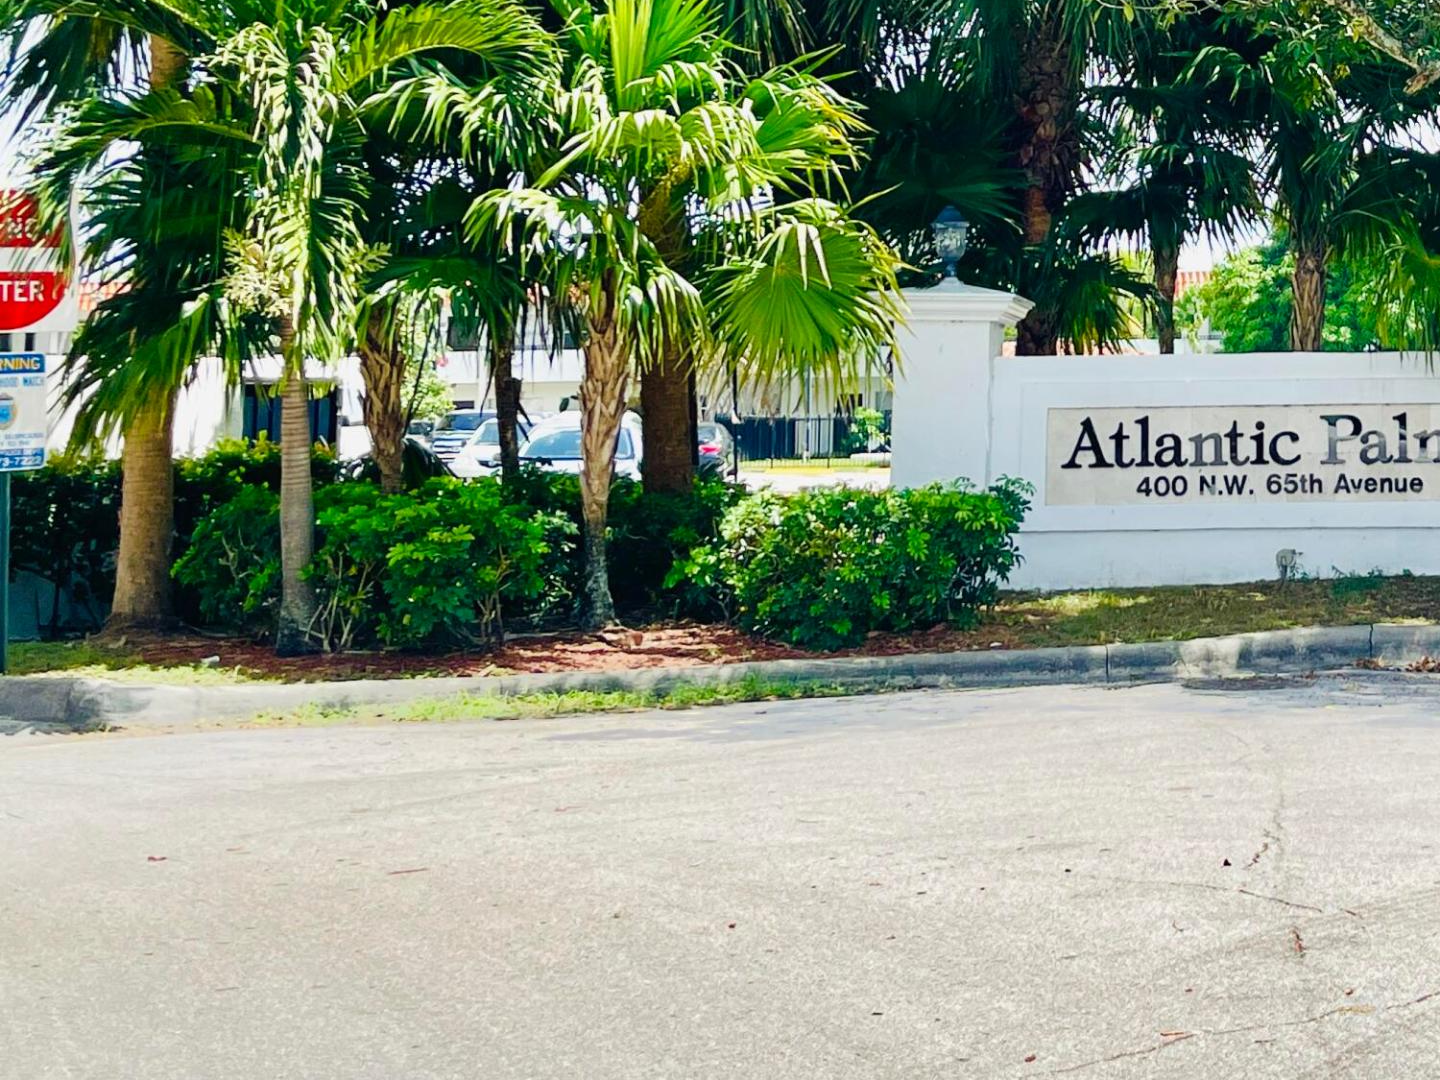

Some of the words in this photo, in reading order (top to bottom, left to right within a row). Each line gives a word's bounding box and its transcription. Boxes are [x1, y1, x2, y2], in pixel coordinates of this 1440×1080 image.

[1060, 415, 1302, 469] Atlantic
[1136, 475, 1188, 497] 400
[1199, 474, 1255, 497] N.W.
[1265, 473, 1323, 495] 65th
[1333, 473, 1424, 495] Avenue
